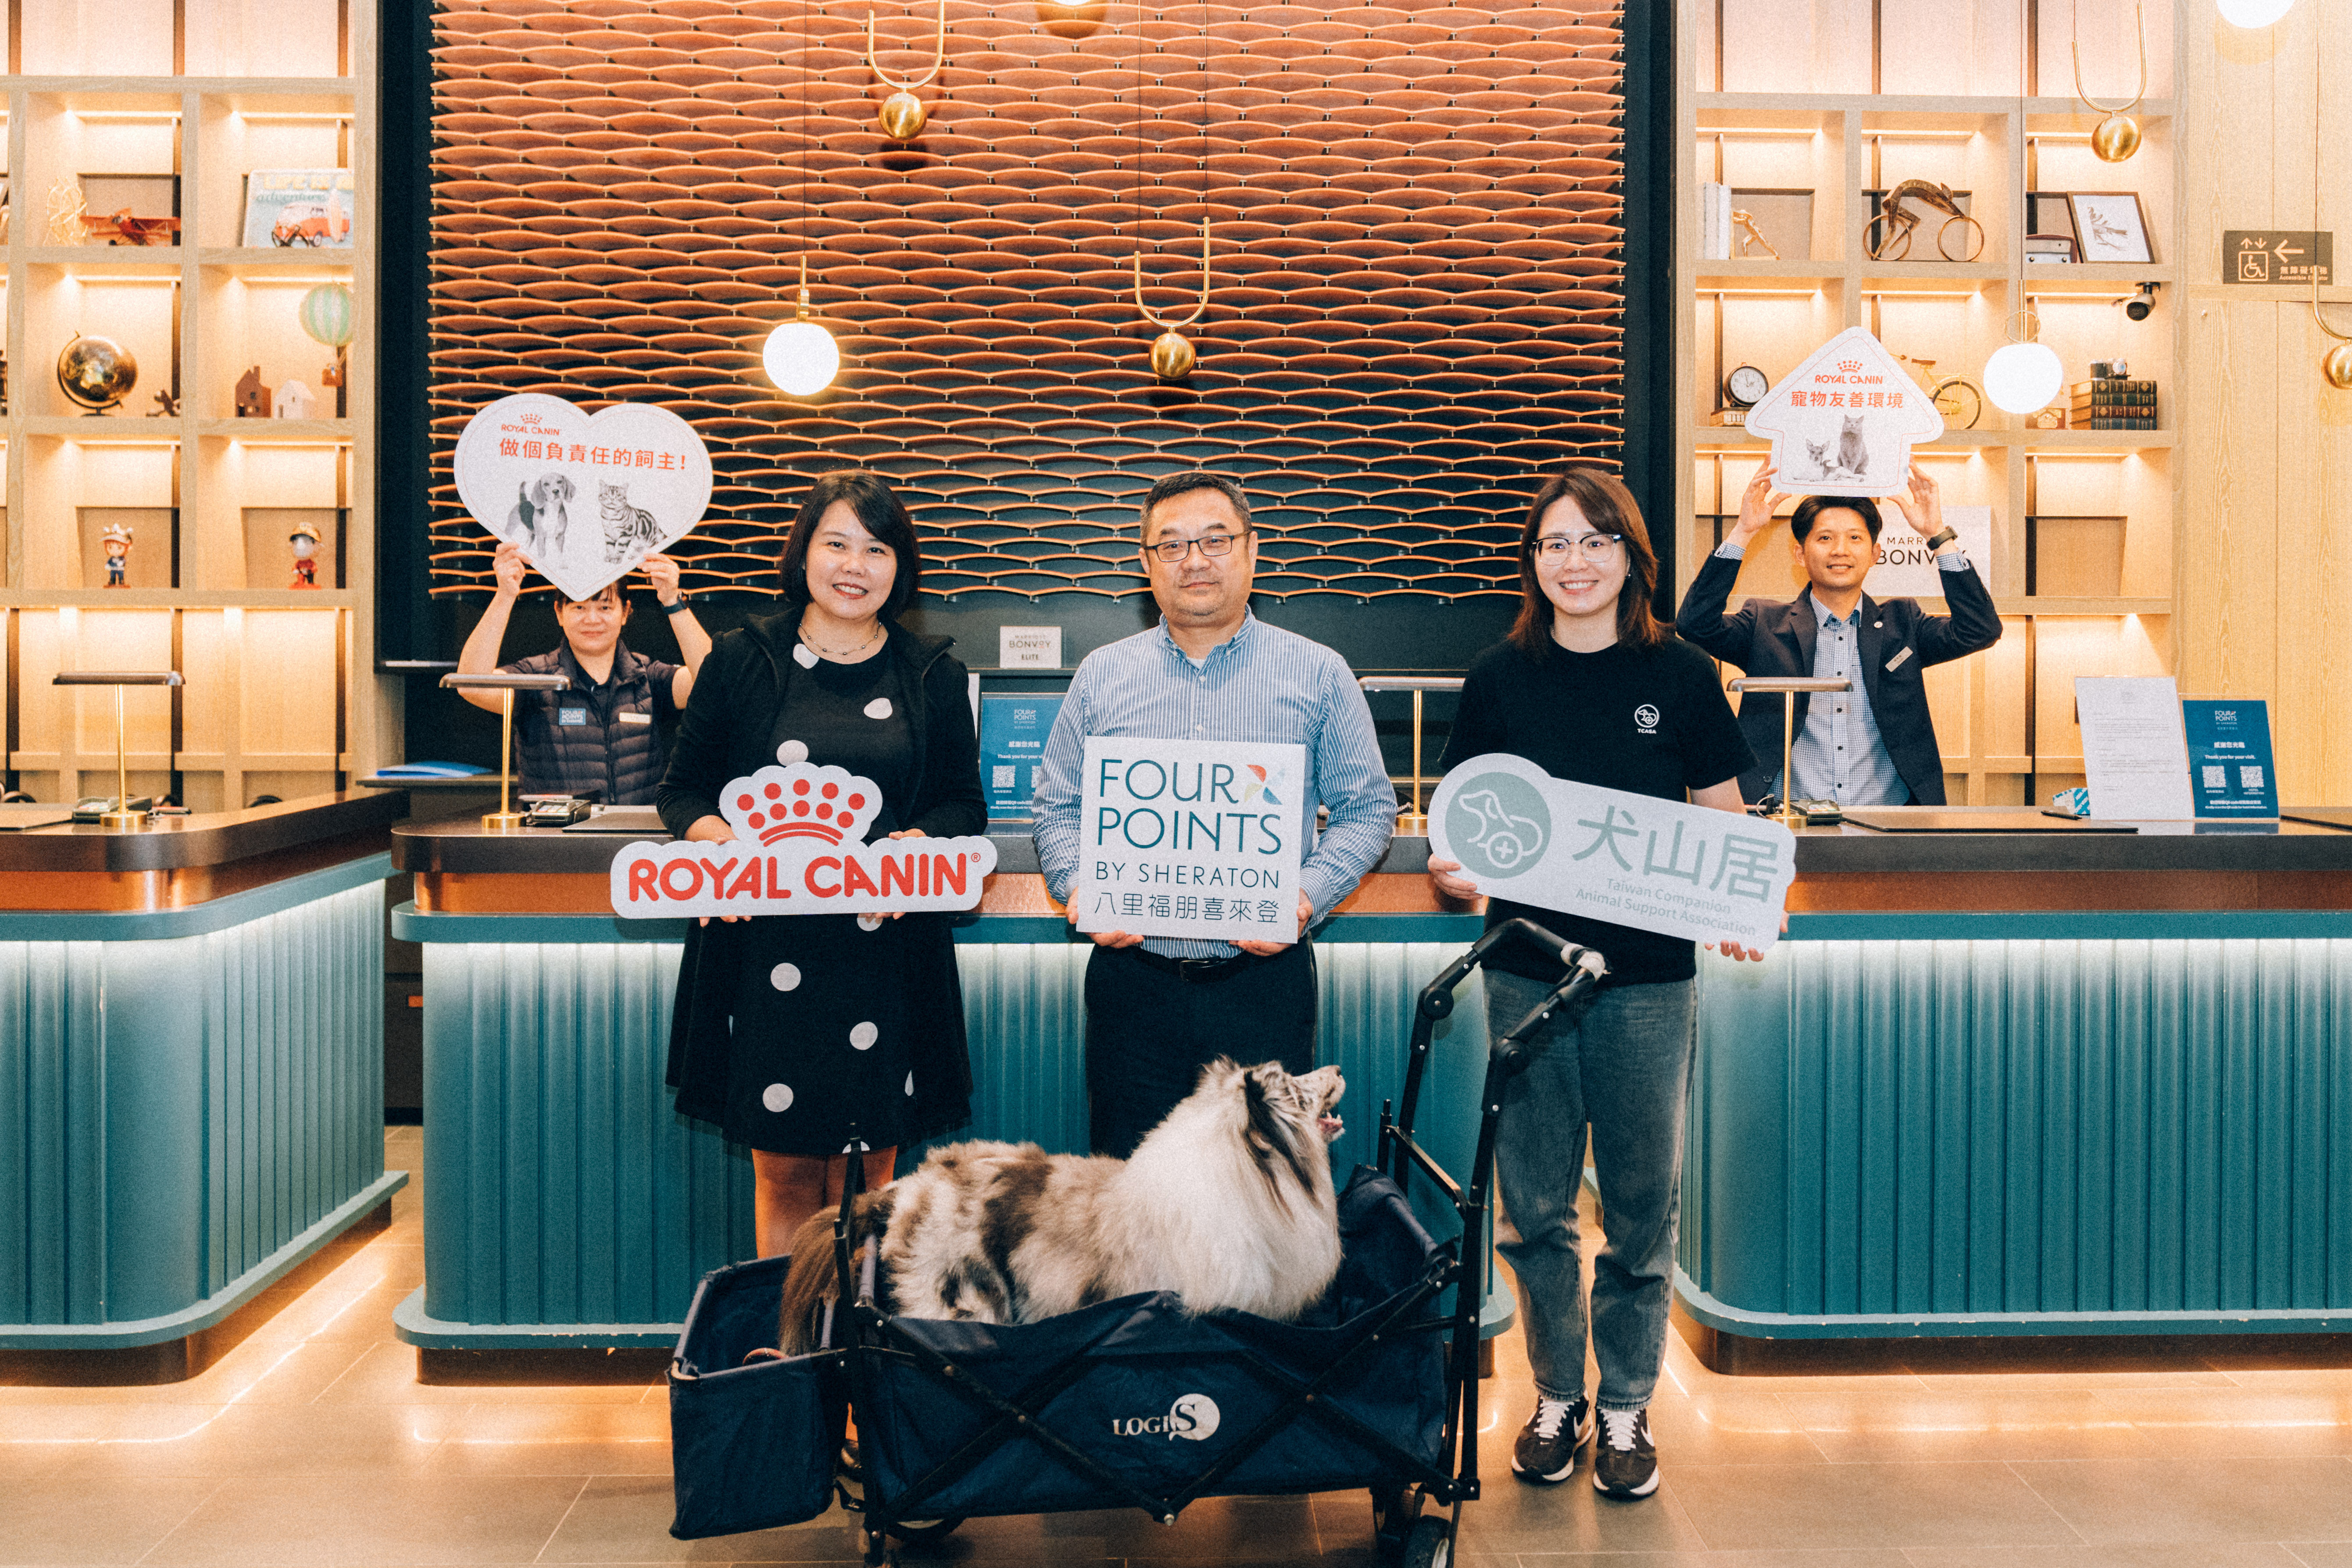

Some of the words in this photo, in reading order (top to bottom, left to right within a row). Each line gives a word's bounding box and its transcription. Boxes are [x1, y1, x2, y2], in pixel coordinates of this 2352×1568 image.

[1815, 375, 1846, 384] ROYAL
[1849, 375, 1883, 384] CANIN
[1791, 390, 1903, 408] 寵物友善環境
[501, 424, 529, 433] ROYAL
[531, 427, 559, 436] CANIN
[1100, 758, 1239, 804] FOUR
[1097, 807, 1281, 855] POINTS
[1573, 805, 1778, 903] 犬山居
[629, 857, 792, 902] ROYAL
[1096, 861, 1126, 881] BY
[1139, 863, 1279, 889] SHERATON
[1095, 892, 1279, 923] 八里福朋喜來登
[1576, 889, 1621, 907] Animal
[1624, 898, 1677, 919] Support
[1680, 910, 1755, 936] Association
[1607, 878, 1652, 898] Taiwan
[1655, 889, 1730, 914] Companion
